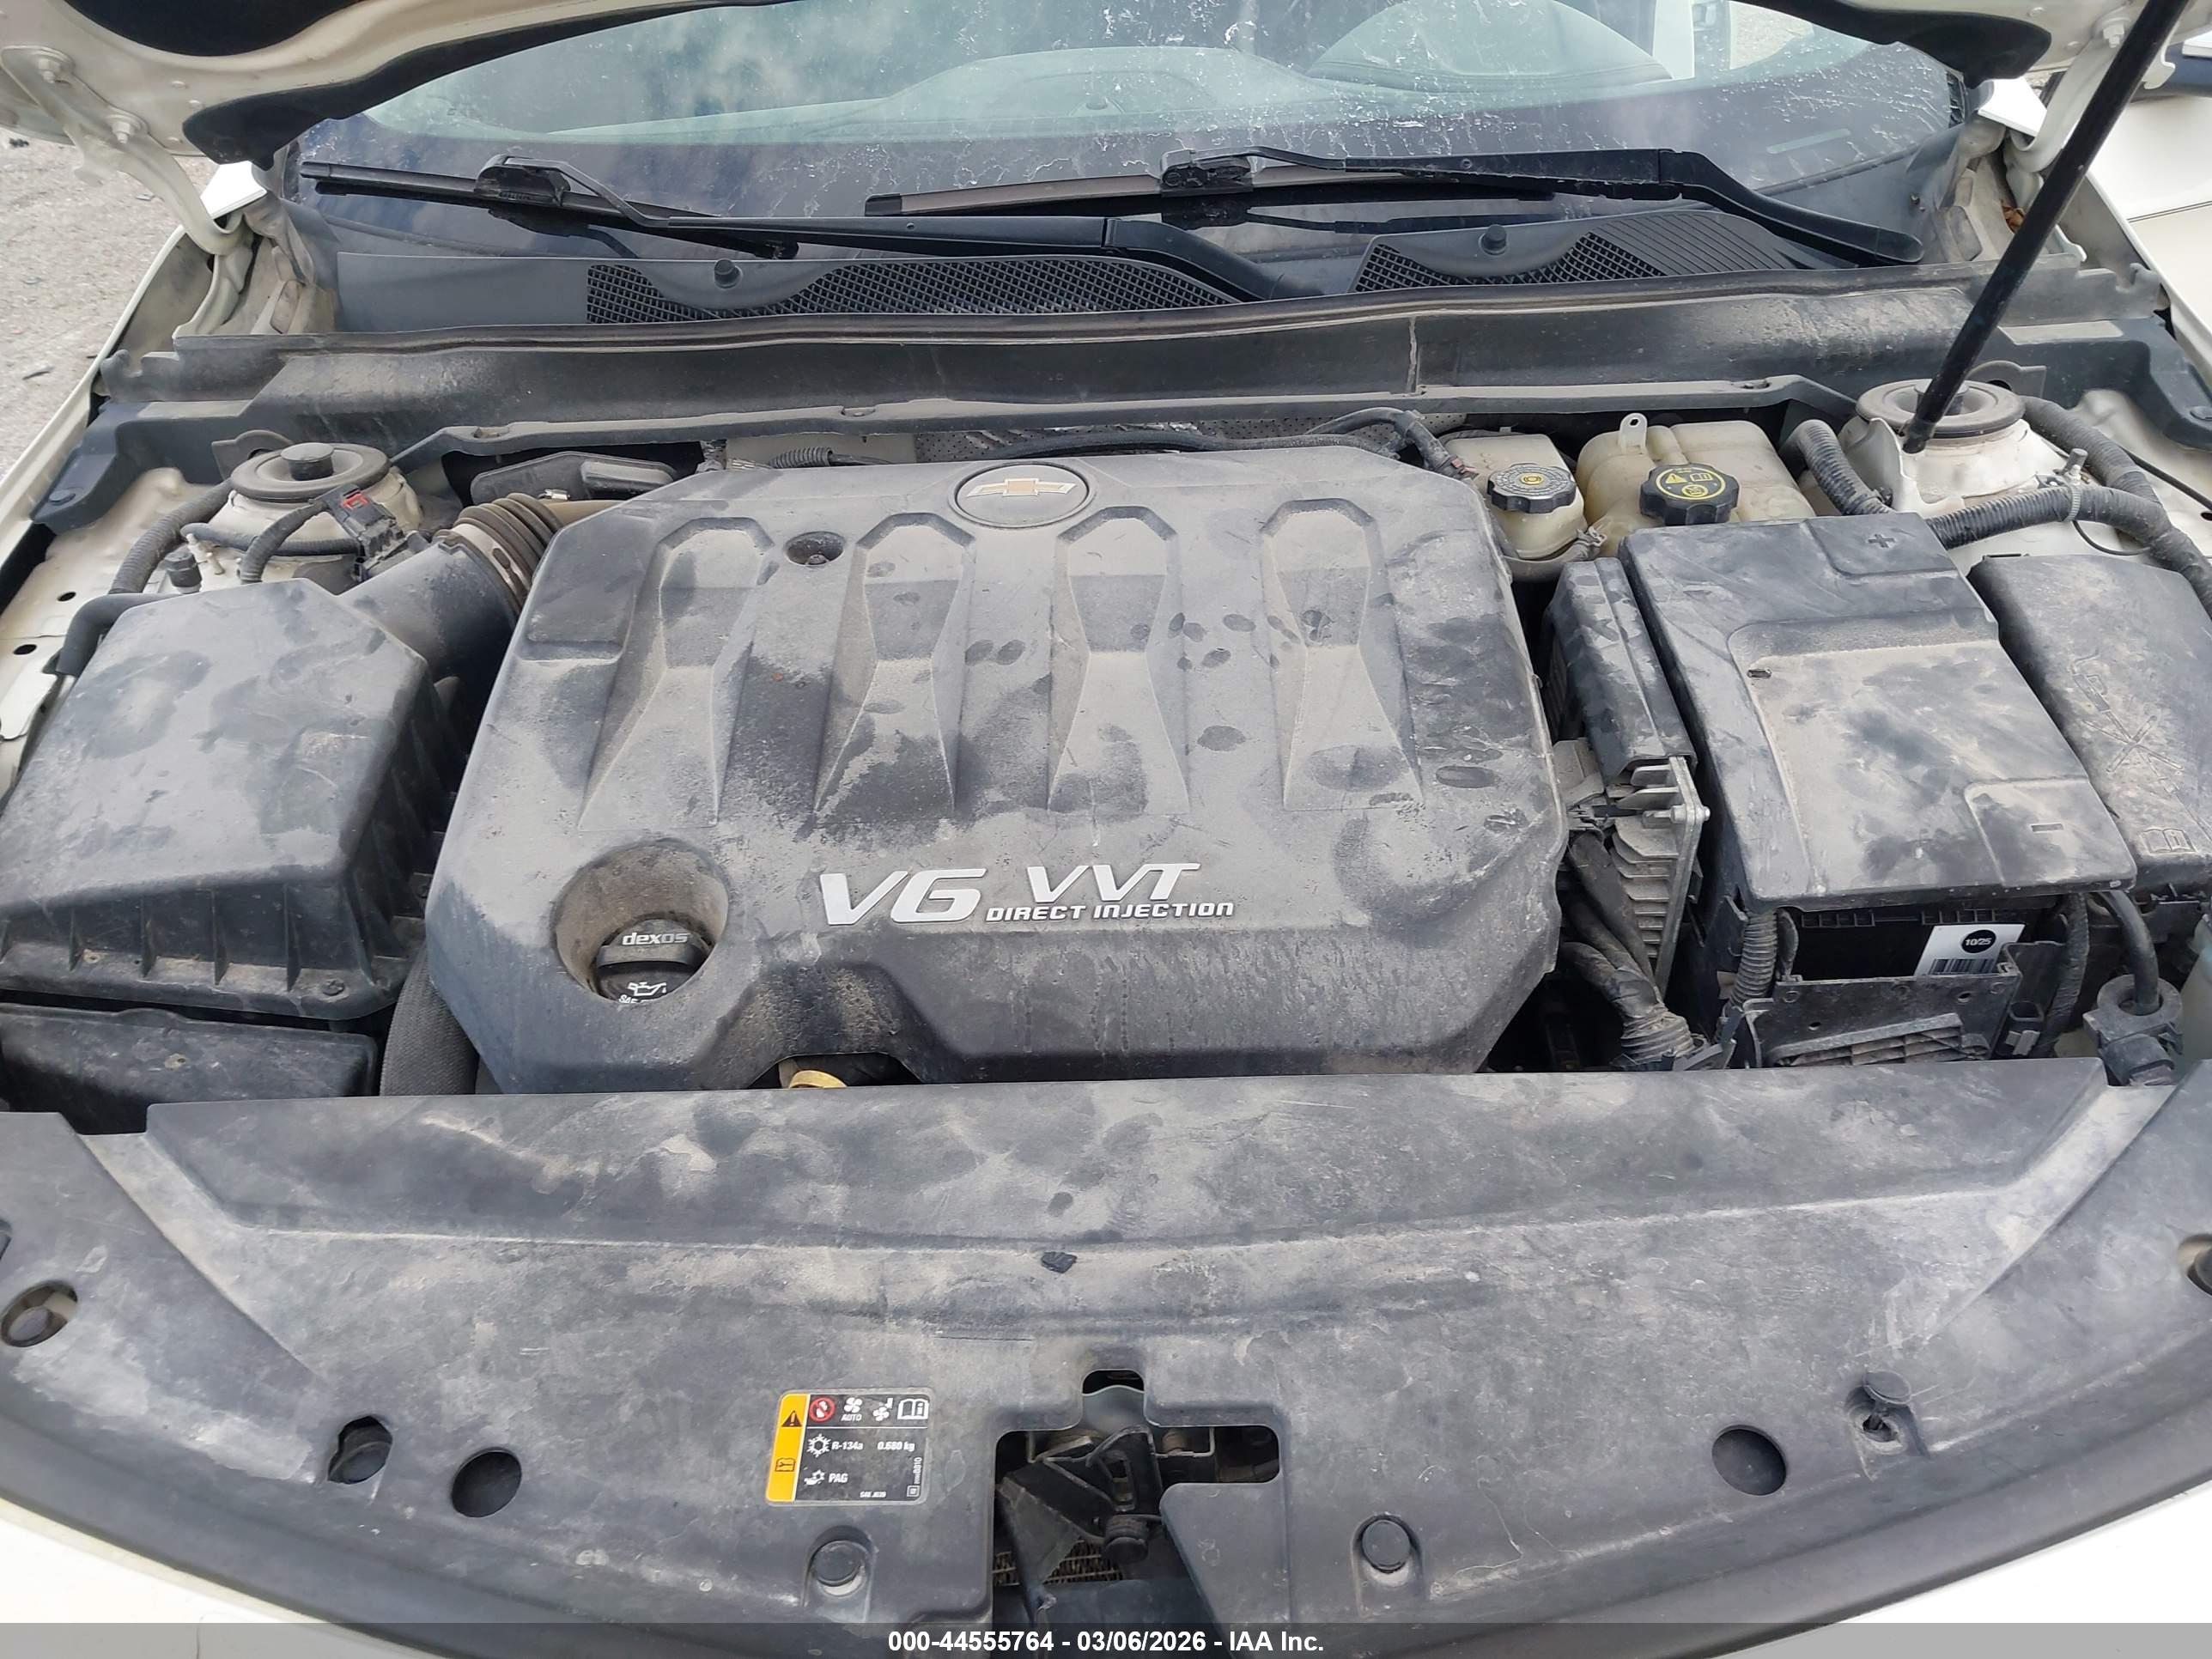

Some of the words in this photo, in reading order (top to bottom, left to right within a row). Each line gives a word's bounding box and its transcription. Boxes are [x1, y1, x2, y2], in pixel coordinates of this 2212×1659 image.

[1026, 862, 1201, 903] VVT
[819, 870, 988, 926] V6
[985, 904, 1087, 922] DIRECT
[1091, 902, 1236, 920] INJECTION
[622, 932, 690, 945] dexos
[840, 1413, 863, 1422] AUTO
[831, 1441, 864, 1450] R-134a
[903, 1441, 916, 1452] kg
[828, 1472, 849, 1484] PAG
